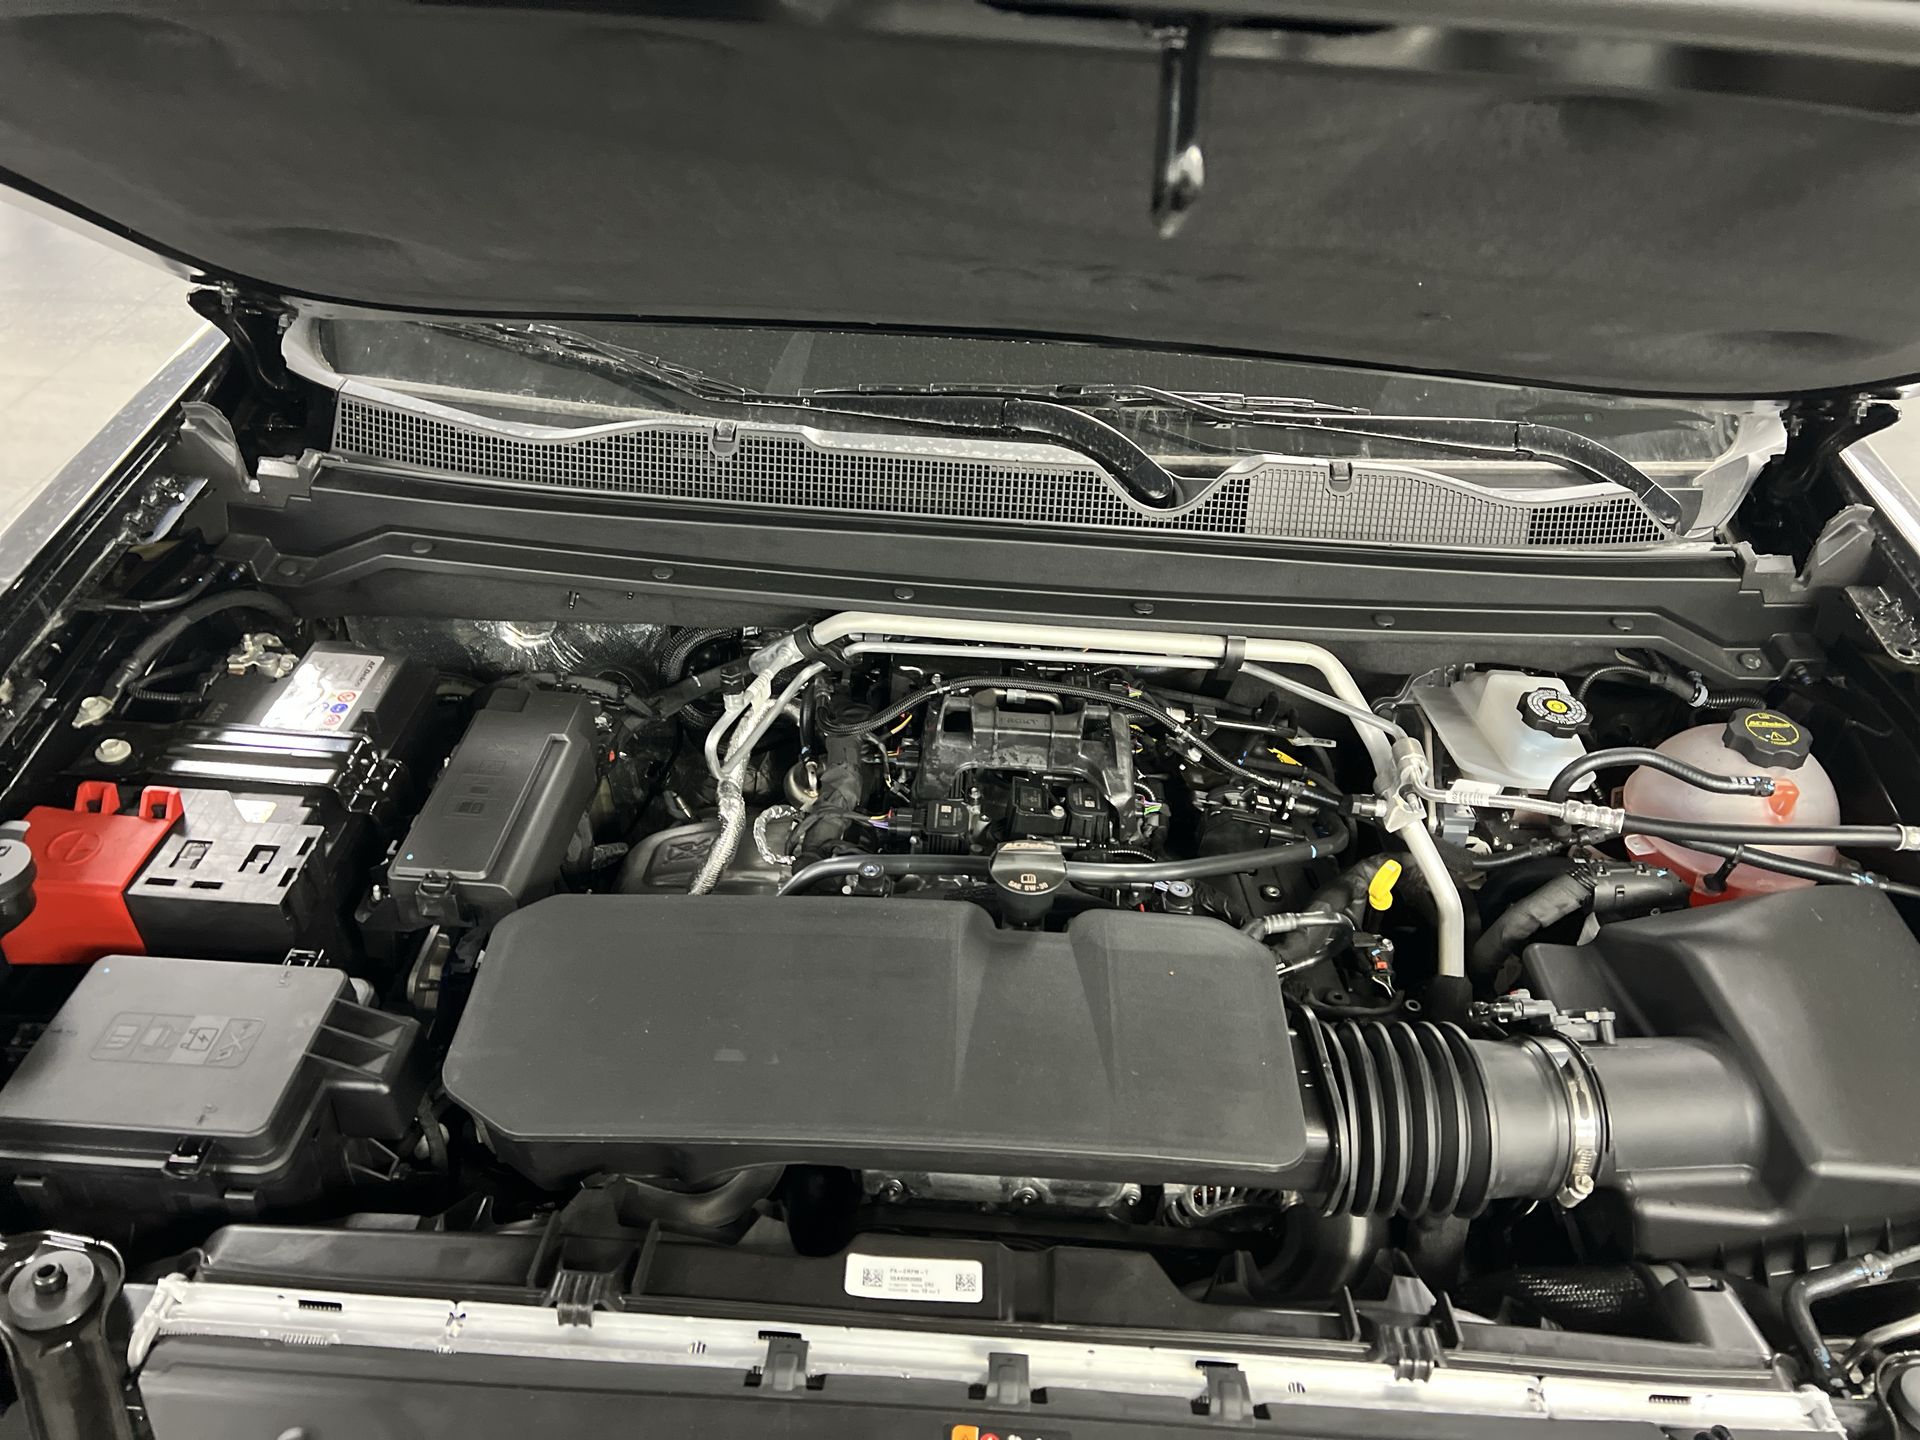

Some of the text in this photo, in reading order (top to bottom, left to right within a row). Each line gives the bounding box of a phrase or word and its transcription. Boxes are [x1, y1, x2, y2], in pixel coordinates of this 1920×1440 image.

[1748, 720, 1791, 728] ACDelco
[1000, 842, 1056, 851] ACDelco
[1008, 880, 1049, 892] SAE 5W-30
